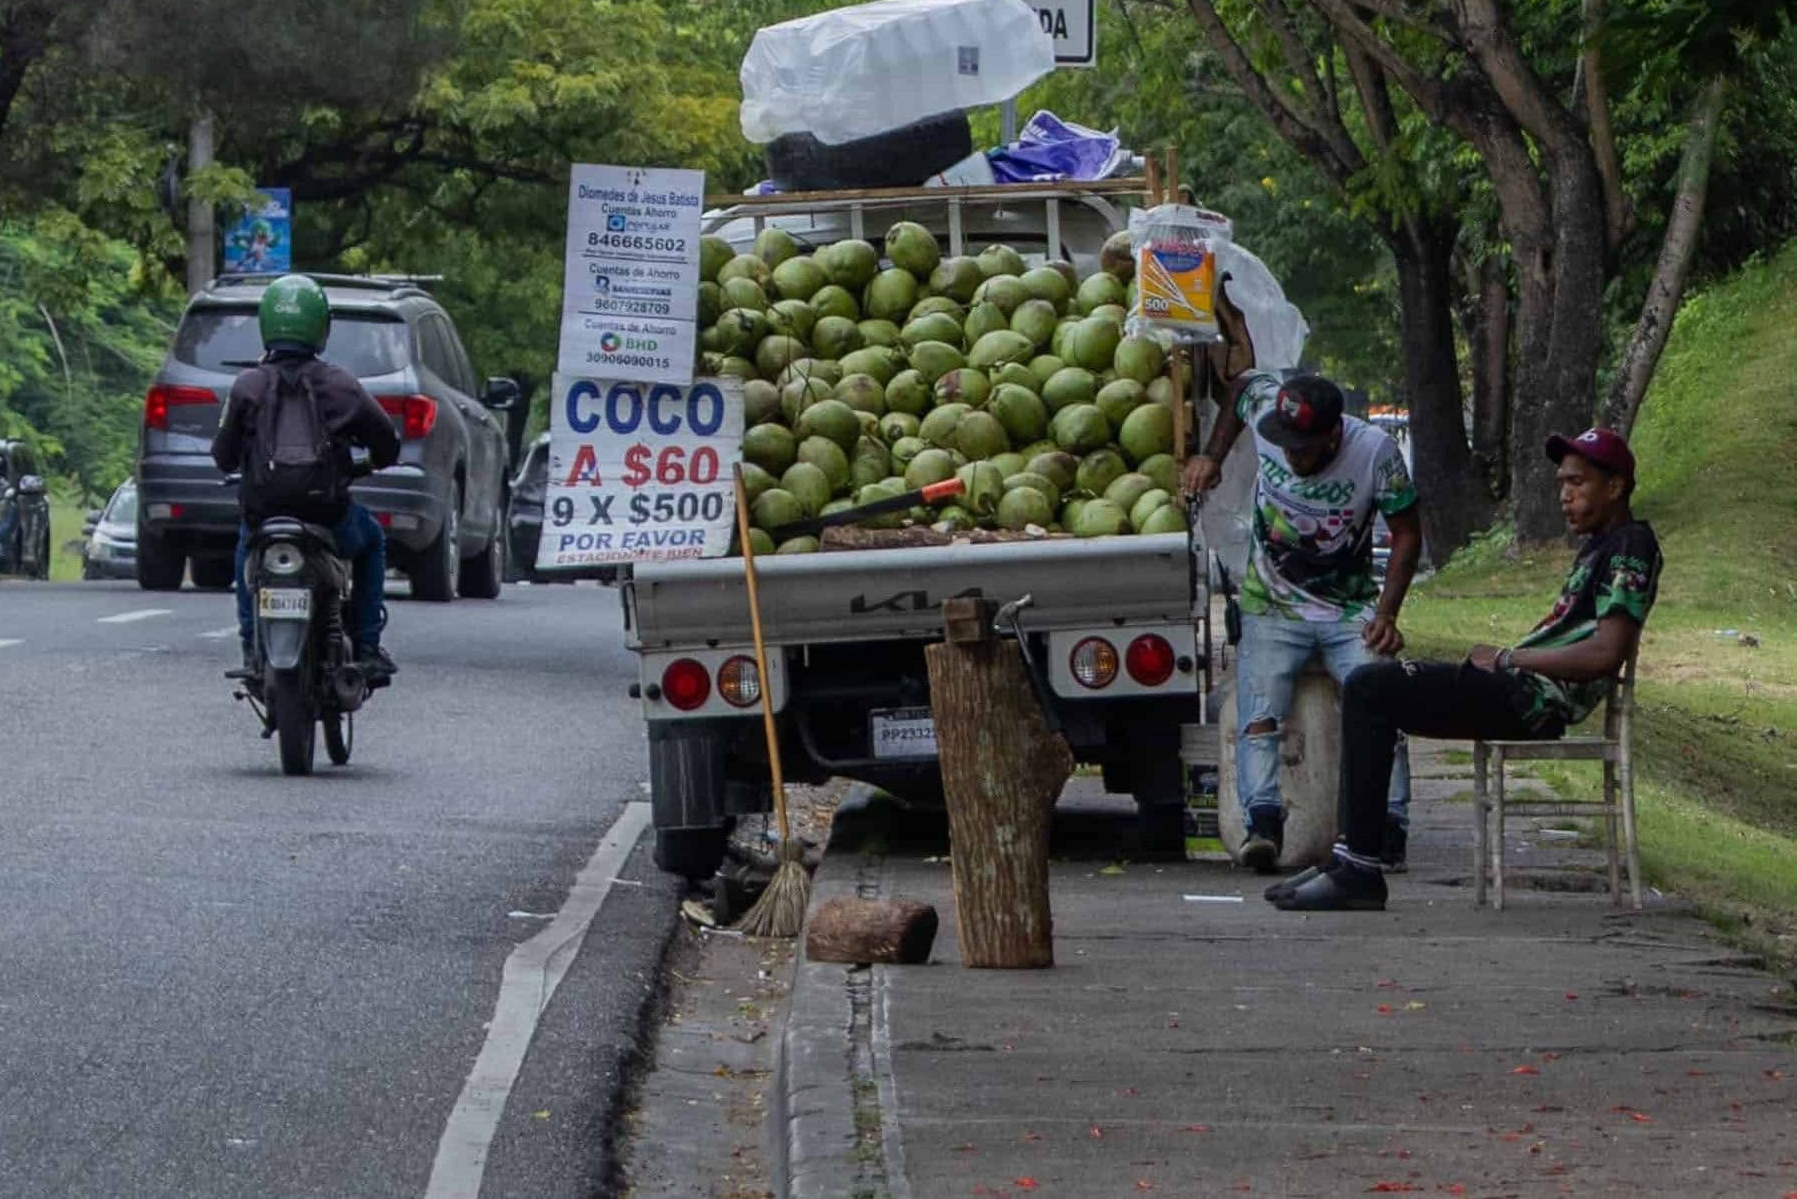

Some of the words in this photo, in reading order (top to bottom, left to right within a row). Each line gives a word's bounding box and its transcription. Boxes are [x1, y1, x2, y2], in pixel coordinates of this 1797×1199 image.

[645, 206, 677, 218] Ahorro
[589, 263, 630, 276] Cuentas
[632, 266, 644, 276] de
[647, 268, 680, 280] Ahorro
[626, 338, 658, 351] BHD
[566, 381, 724, 436] COCO
[565, 444, 602, 487] A
[622, 442, 719, 491] $60
[553, 497, 574, 527] 9
[587, 495, 615, 525] X
[628, 492, 723, 527] $500
[559, 533, 613, 551] POR
[621, 529, 706, 550] FAVOR
[666, 547, 703, 561] BIEN
